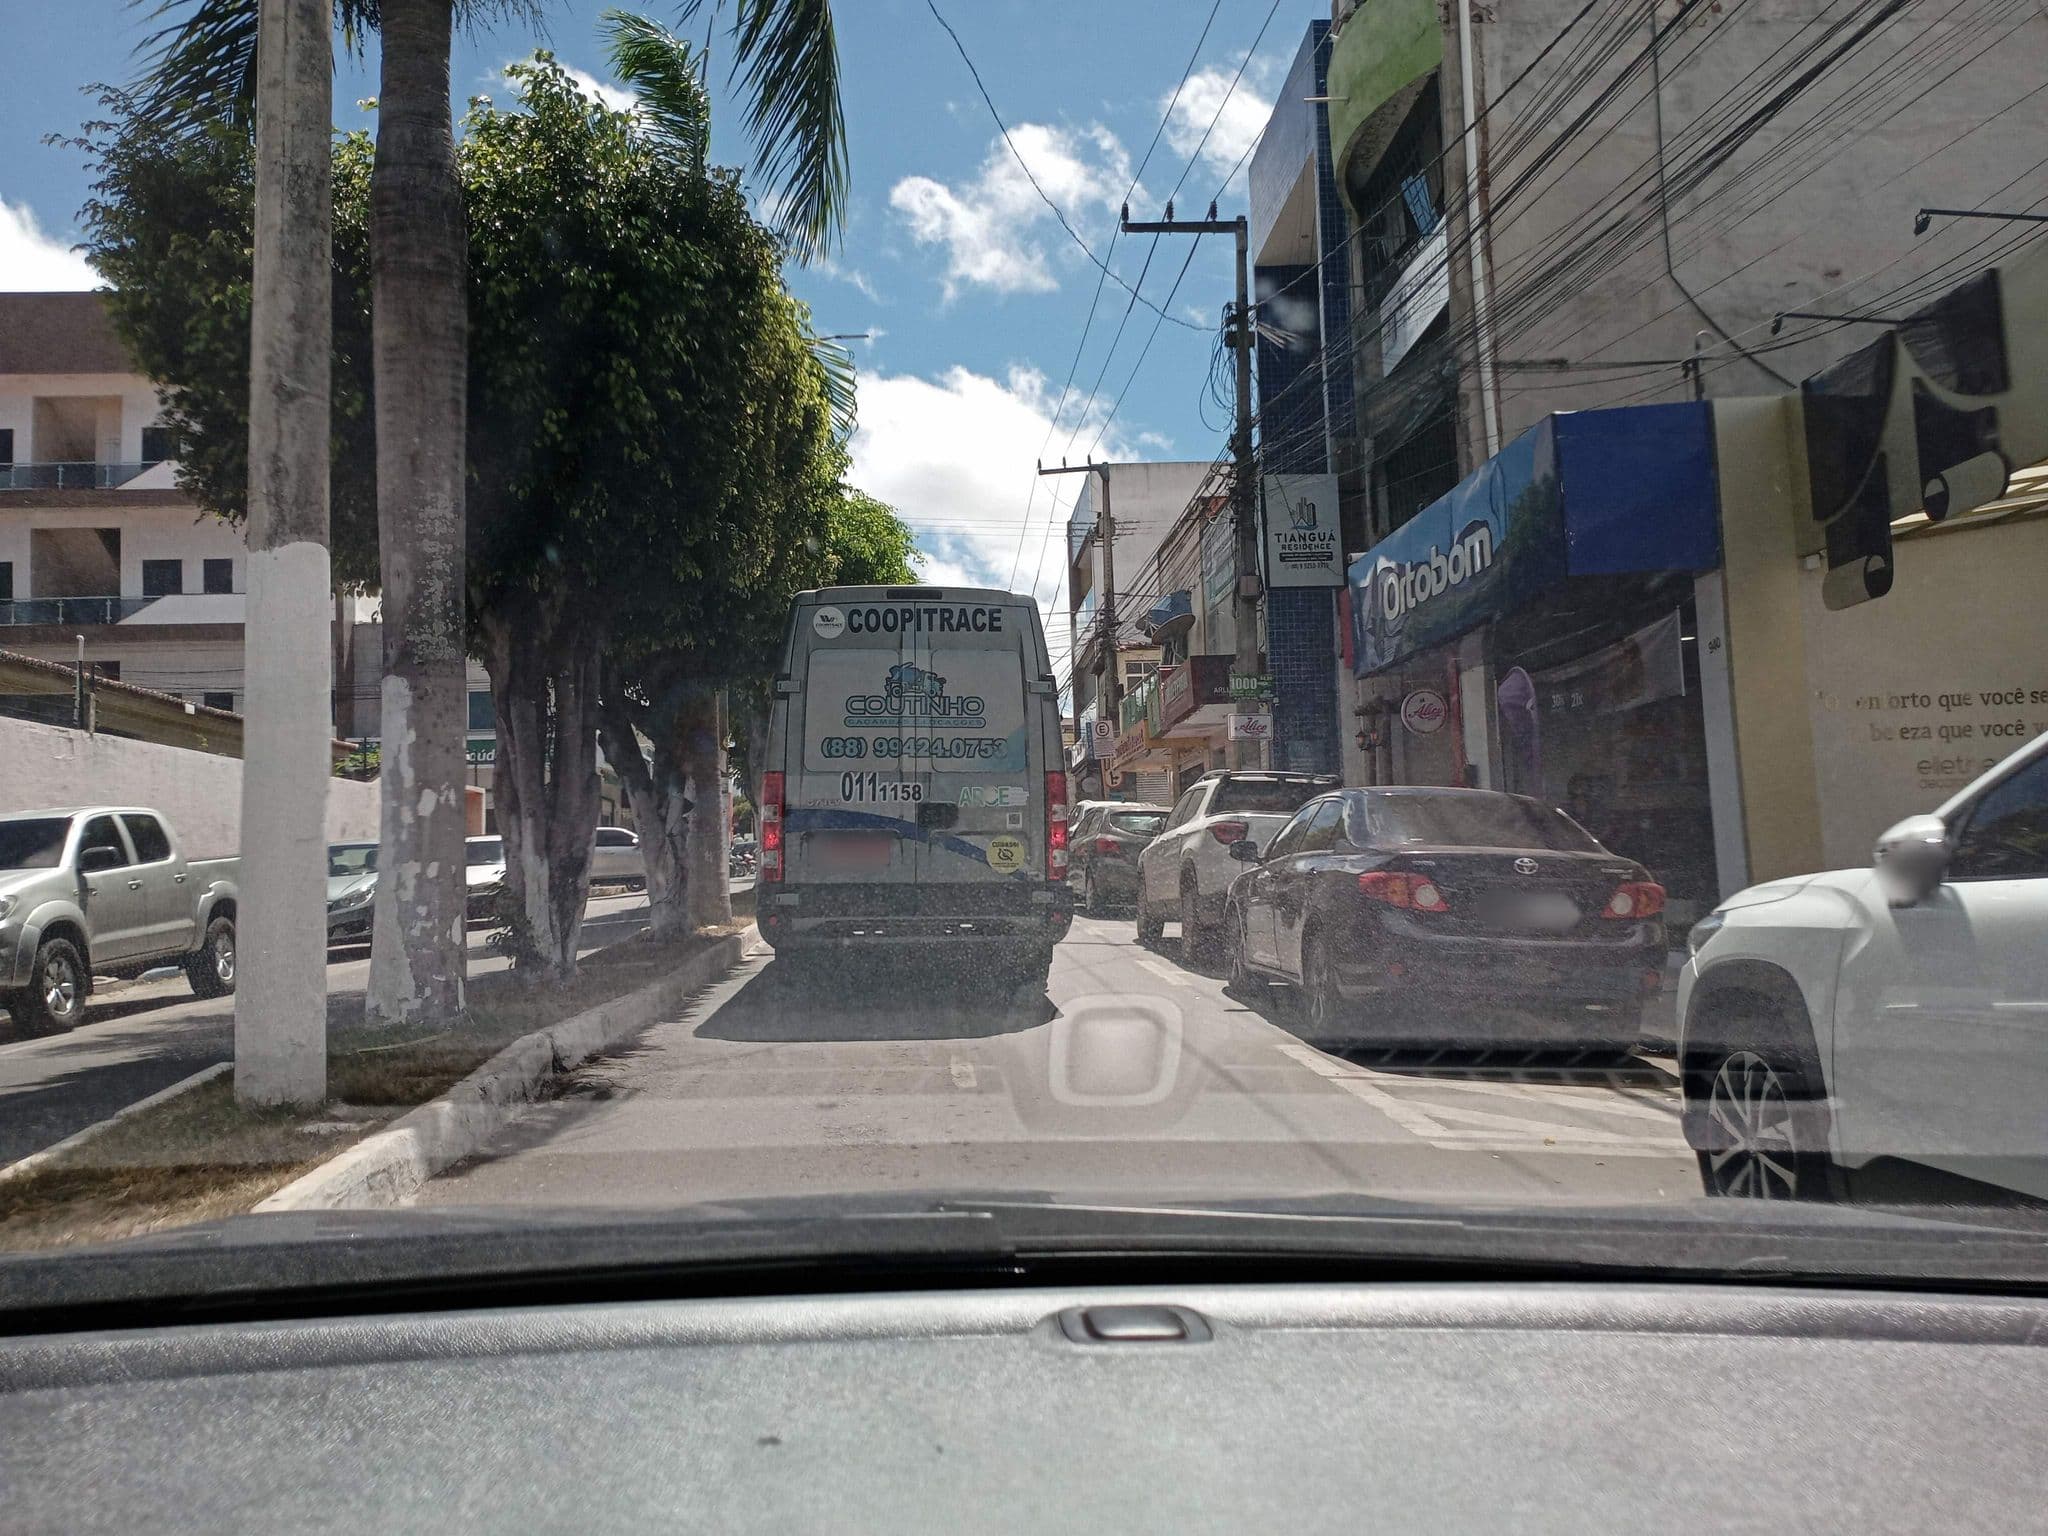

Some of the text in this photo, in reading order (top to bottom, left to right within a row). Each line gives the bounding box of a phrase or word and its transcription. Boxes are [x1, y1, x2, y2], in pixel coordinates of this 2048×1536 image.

[1274, 530, 1336, 543] TIANGUÁ
[1281, 543, 1331, 551] RESIDENCE
[1382, 526, 1493, 621] Ortobom
[847, 607, 1002, 633] COOPITRACE
[845, 695, 985, 716] COUTINHO
[1938, 693, 1973, 712] que
[1979, 688, 2025, 706] você
[1938, 724, 1972, 743] que
[1980, 719, 2025, 737] você
[820, 736, 868, 759] (88)
